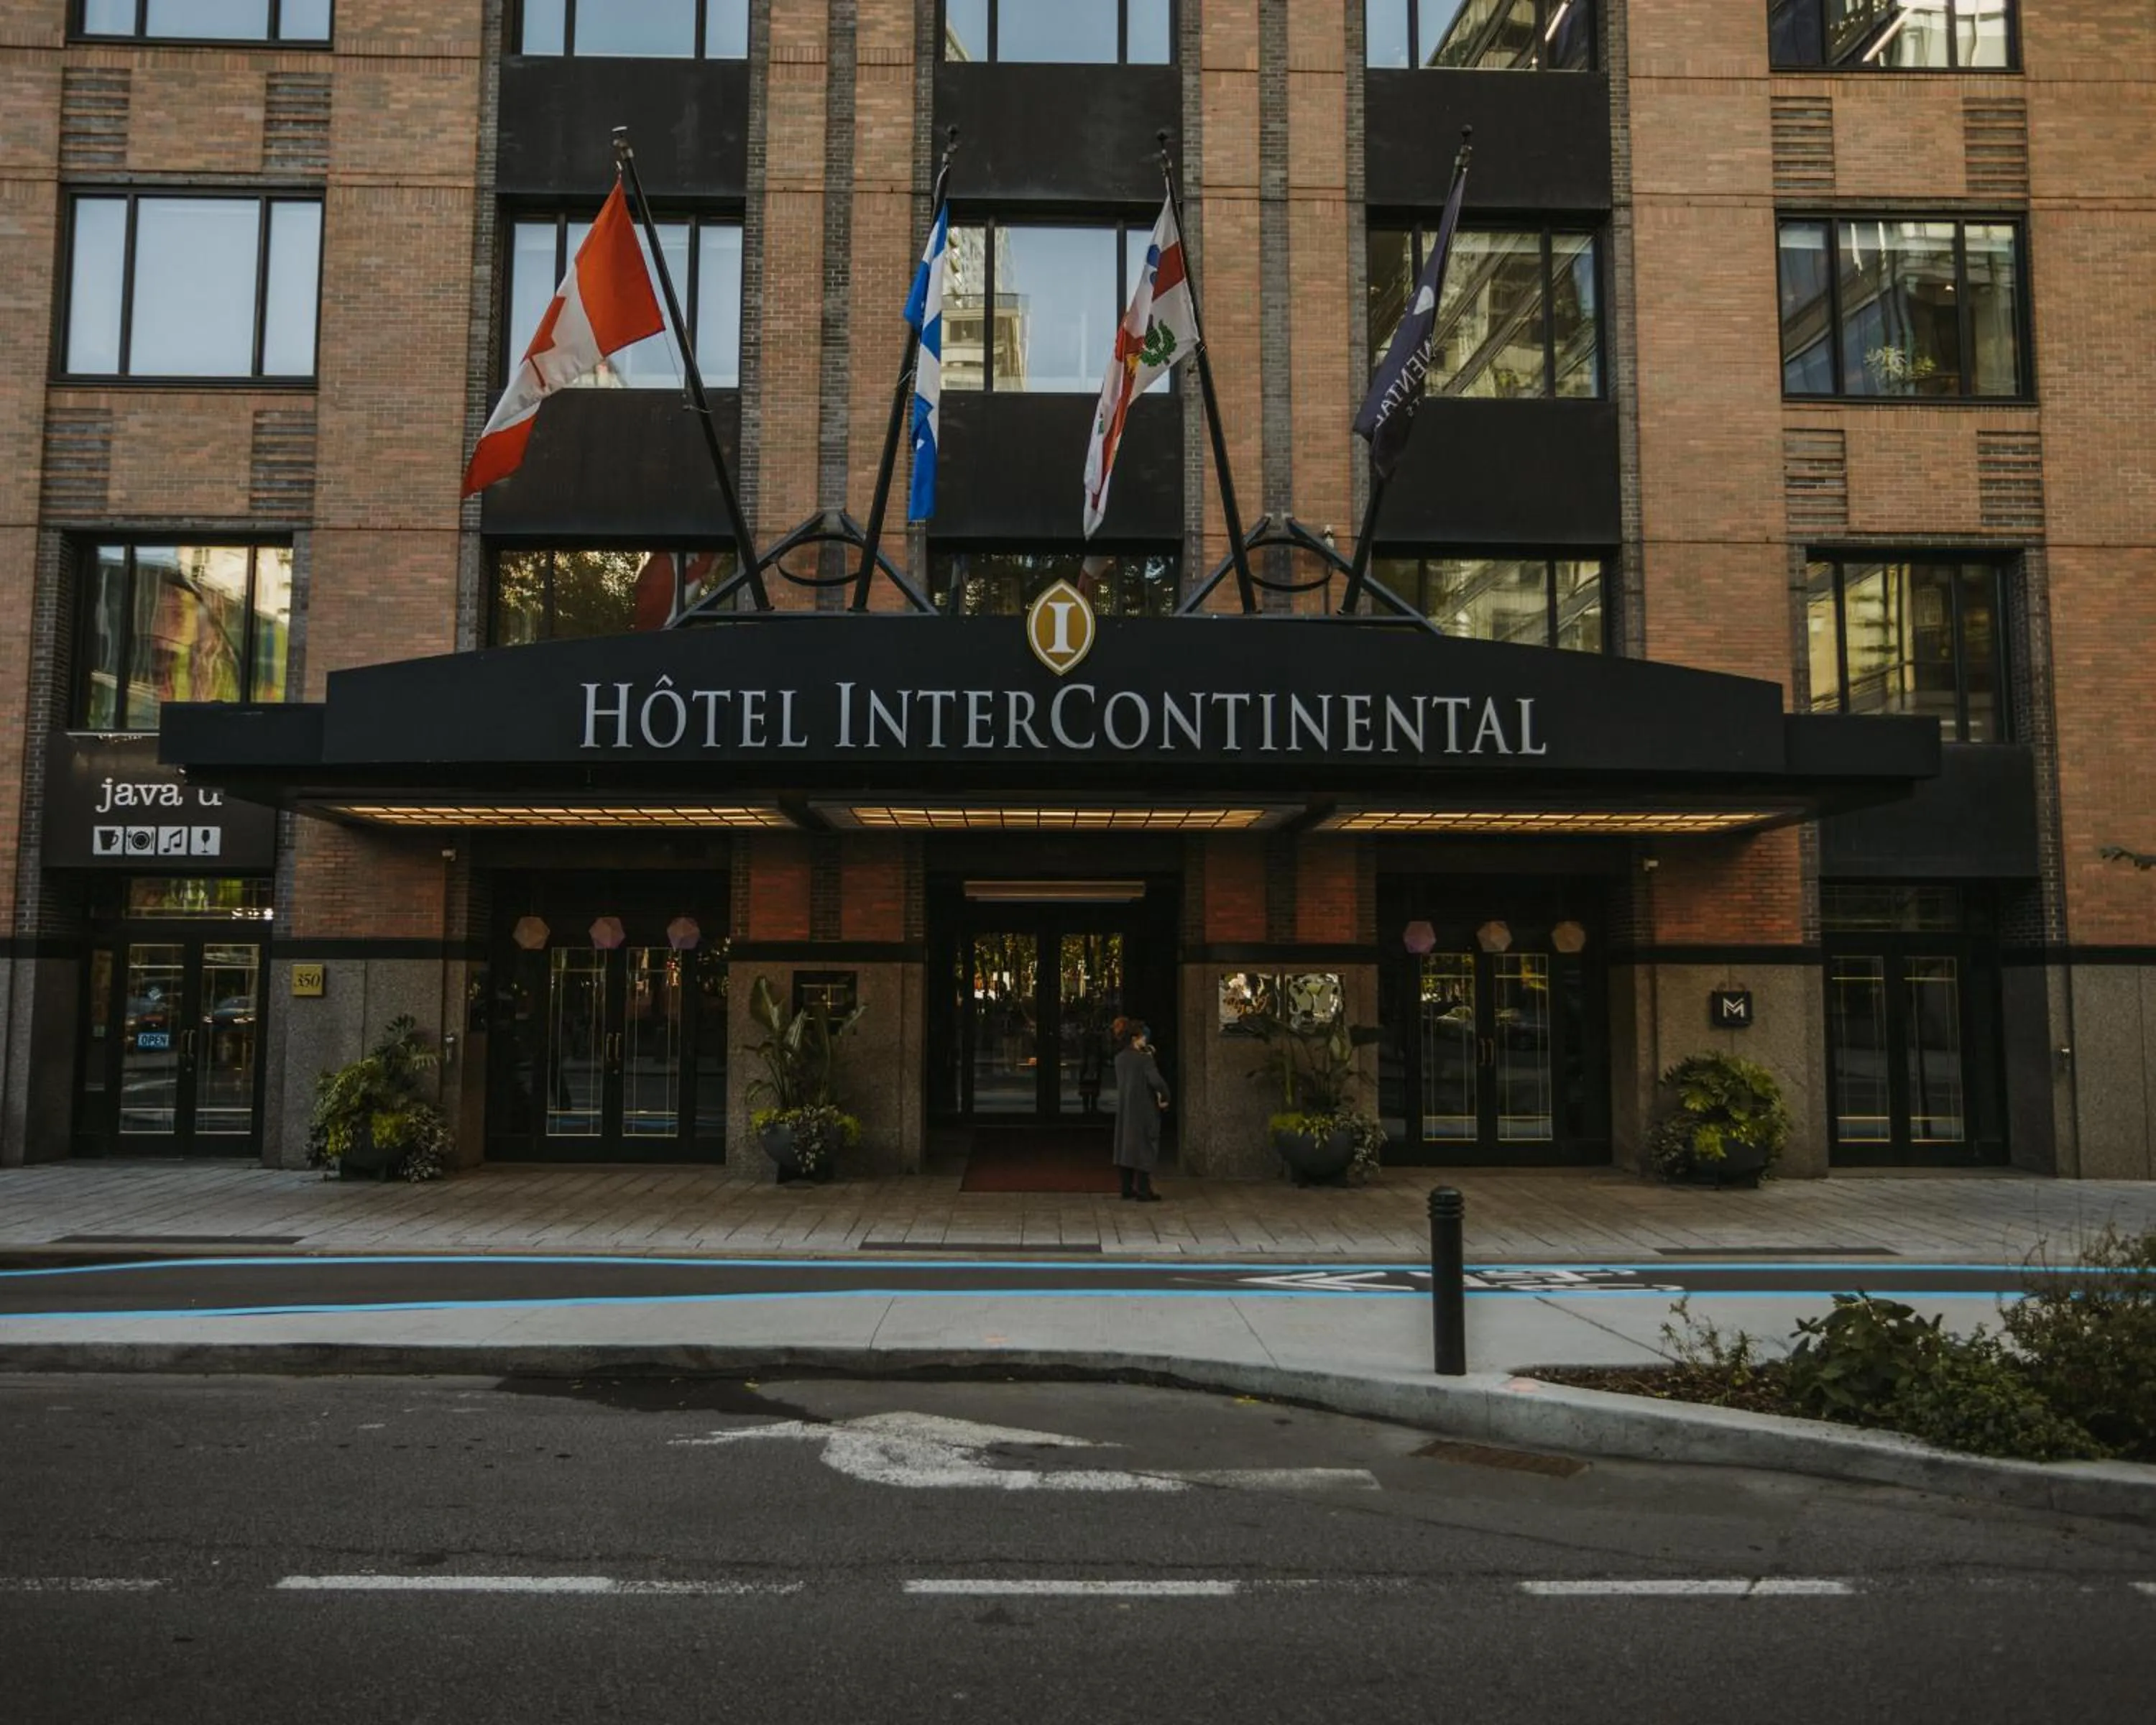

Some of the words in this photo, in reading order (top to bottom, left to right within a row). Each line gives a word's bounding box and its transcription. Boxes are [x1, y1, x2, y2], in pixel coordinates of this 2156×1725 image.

[1046, 601, 1077, 655] I
[579, 673, 808, 748] HÔTEL
[95, 777, 183, 814] java
[294, 972, 321, 988] 350
[1722, 997, 1745, 1018] M
[141, 1035, 167, 1046] OPEN
